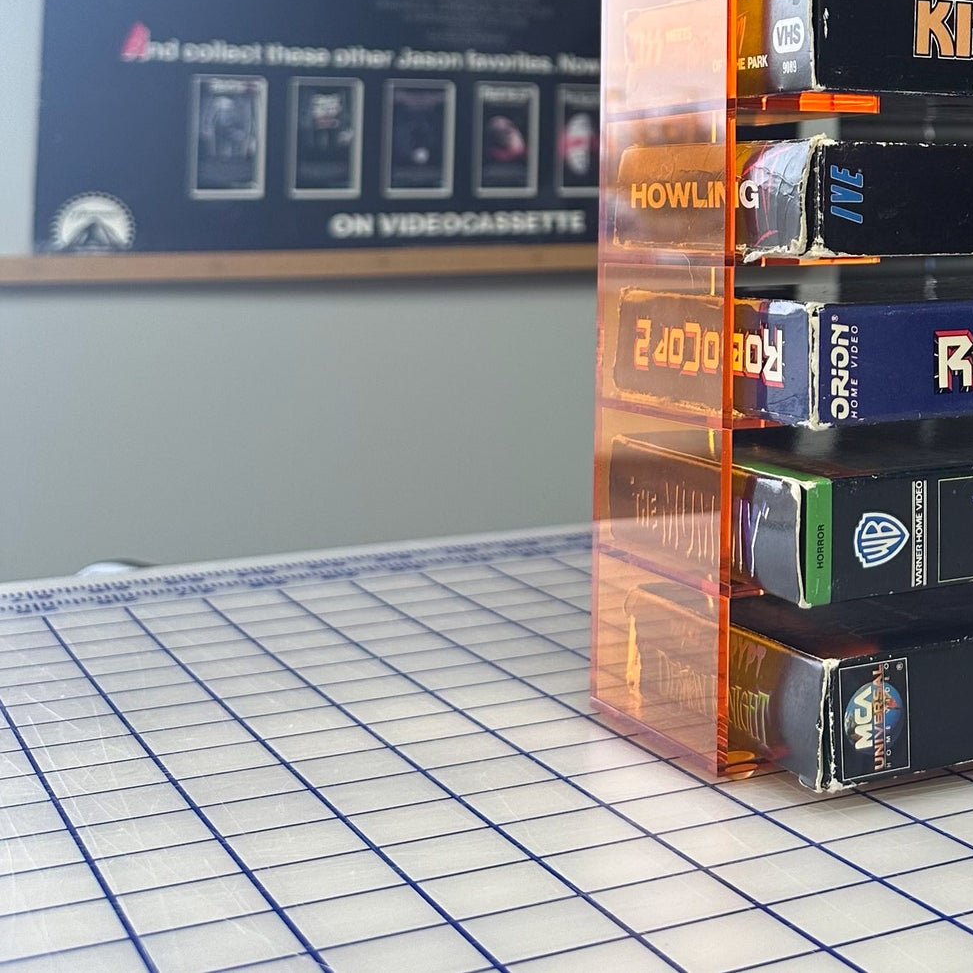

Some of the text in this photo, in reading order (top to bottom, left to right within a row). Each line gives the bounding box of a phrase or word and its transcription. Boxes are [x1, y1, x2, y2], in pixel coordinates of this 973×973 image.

[183, 40, 263, 65] collect
[266, 43, 331, 67] these
[335, 45, 393, 68] other
[399, 47, 463, 72] Jason
[776, 22, 801, 47] VHS
[747, 54, 769, 69] PARK
[782, 59, 797, 75] 9089
[630, 179, 760, 210] HOWLING
[830, 164, 865, 225] IVE
[329, 210, 586, 239] ON VIDEOCASSETTE
[633, 317, 653, 371] 2
[830, 323, 850, 420] ORION
[850, 325, 859, 419] HOME VIDEO
[816, 524, 825, 569] HORROR
[857, 517, 905, 564] WB
[915, 480, 923, 586] WARNER HOME VIDEO
[854, 685, 874, 750] MCA
[872, 662, 885, 771] UNIVERSAL
